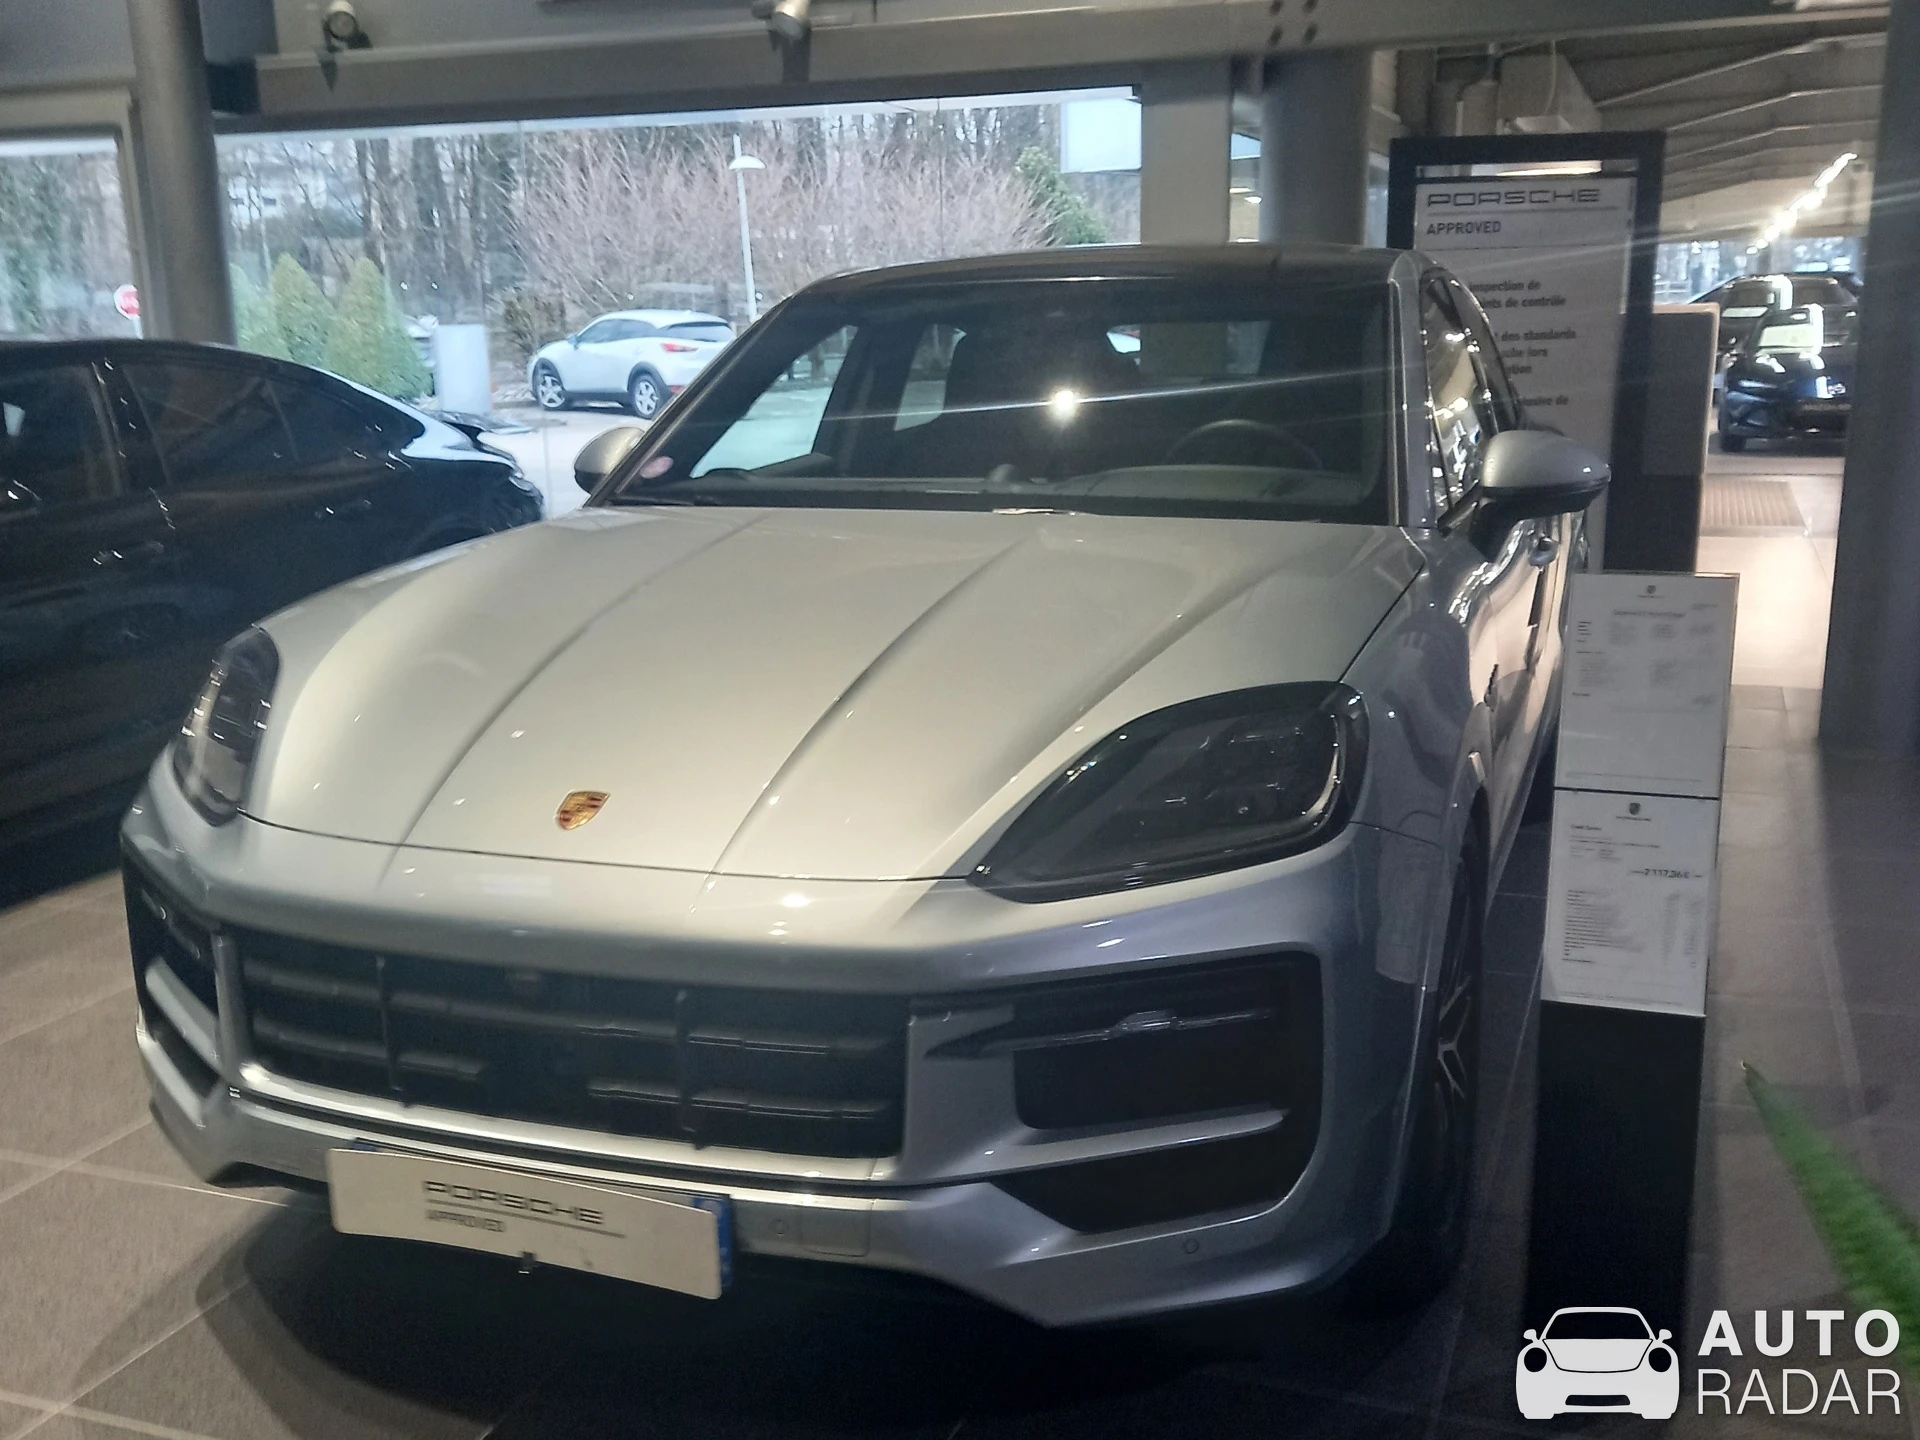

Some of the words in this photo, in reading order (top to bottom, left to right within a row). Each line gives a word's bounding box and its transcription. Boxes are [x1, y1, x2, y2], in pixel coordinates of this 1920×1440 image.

[1427, 188, 1600, 207] PORSCHE
[1427, 220, 1502, 235] APPROVED
[1528, 279, 1541, 291] de
[1505, 297, 1519, 308] de
[1556, 395, 1569, 406] de
[424, 1181, 605, 1225] PORSCHE
[426, 1209, 506, 1233] APPROVED
